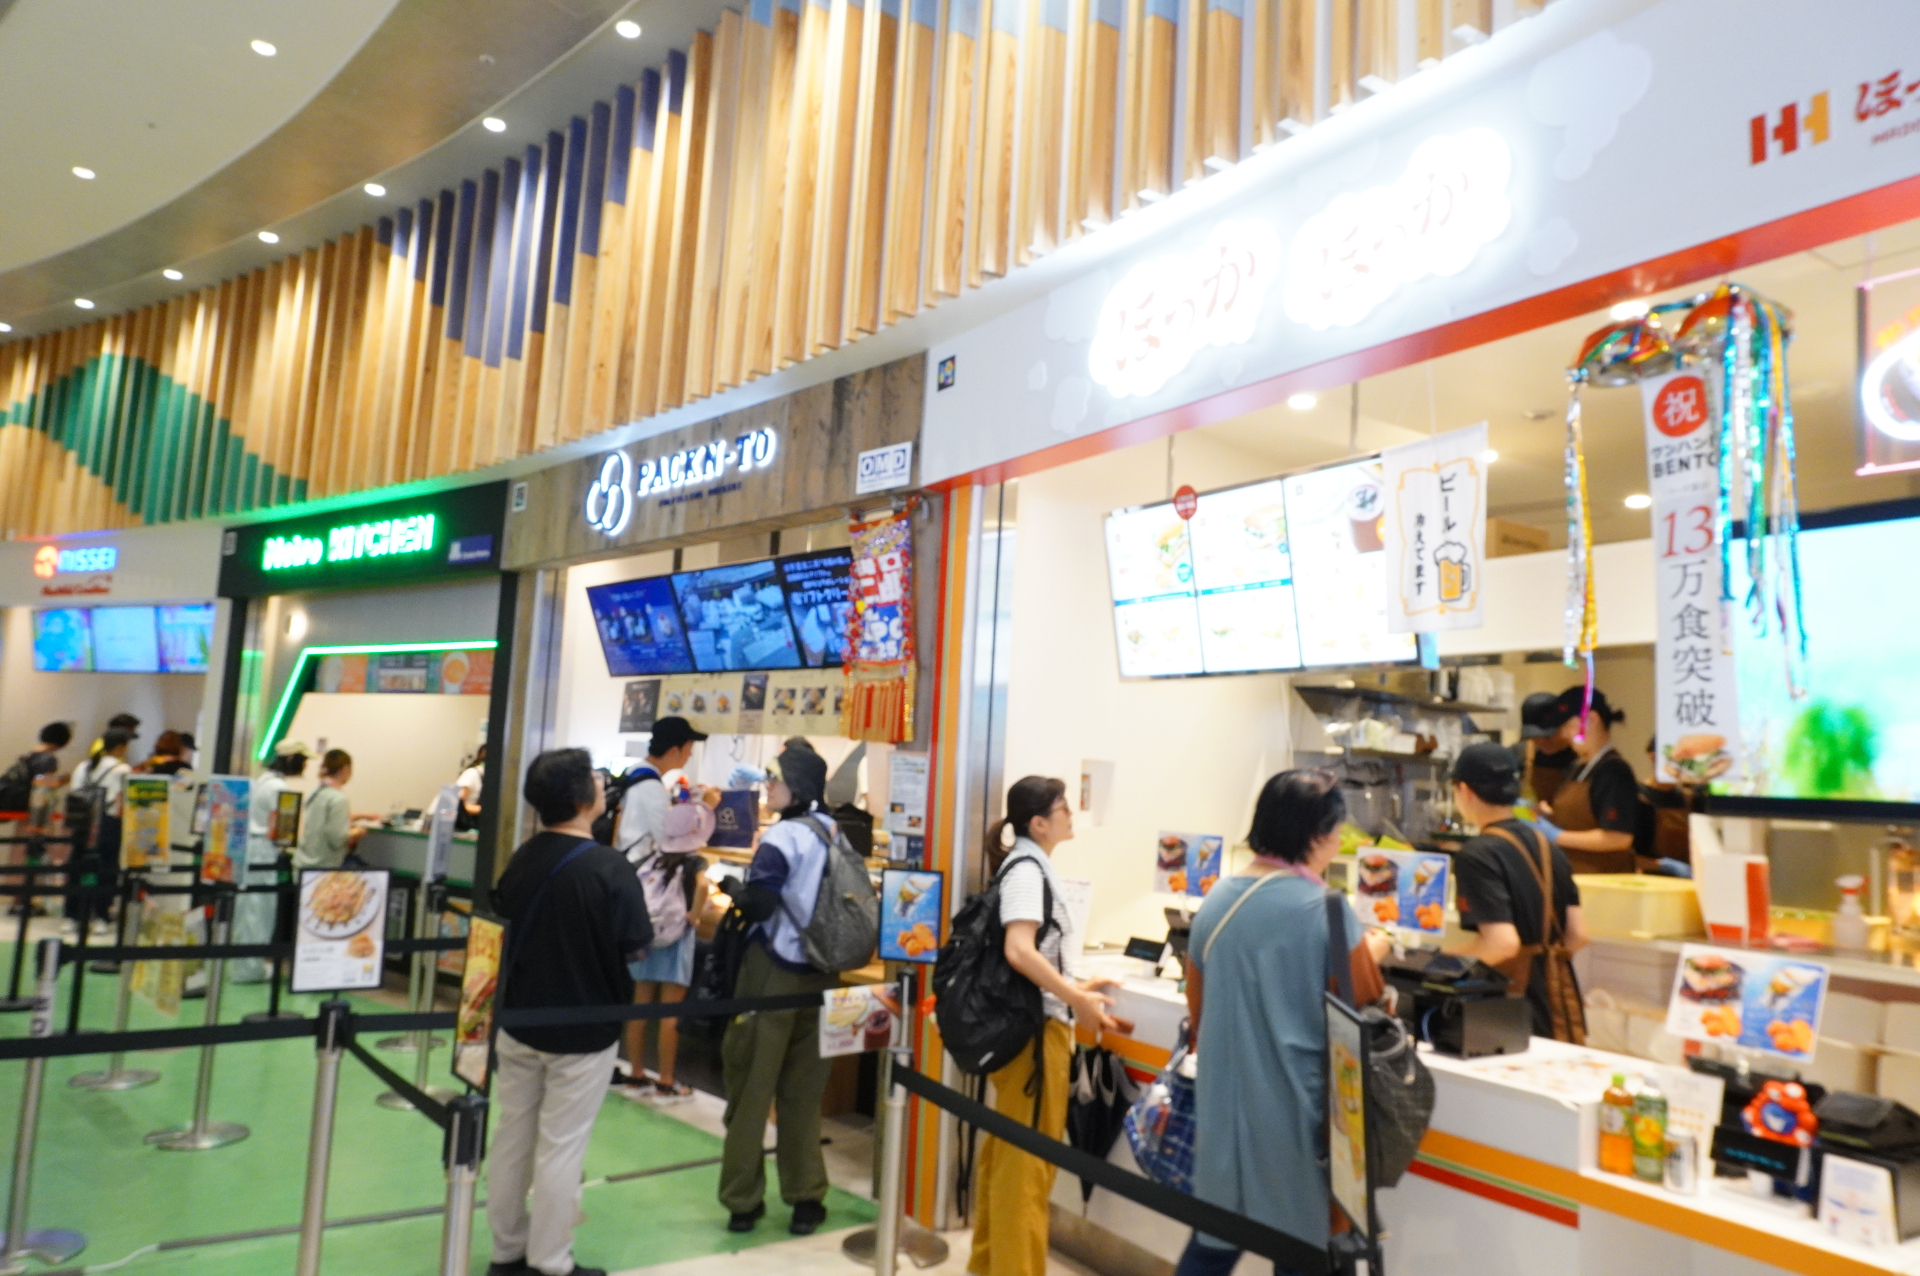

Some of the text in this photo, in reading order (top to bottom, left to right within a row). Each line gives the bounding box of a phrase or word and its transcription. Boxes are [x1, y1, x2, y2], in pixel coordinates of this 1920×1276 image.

[1661, 387, 1700, 428] 祝
[1440, 472, 1457, 535] ビール
[327, 513, 436, 562] KITCHEN
